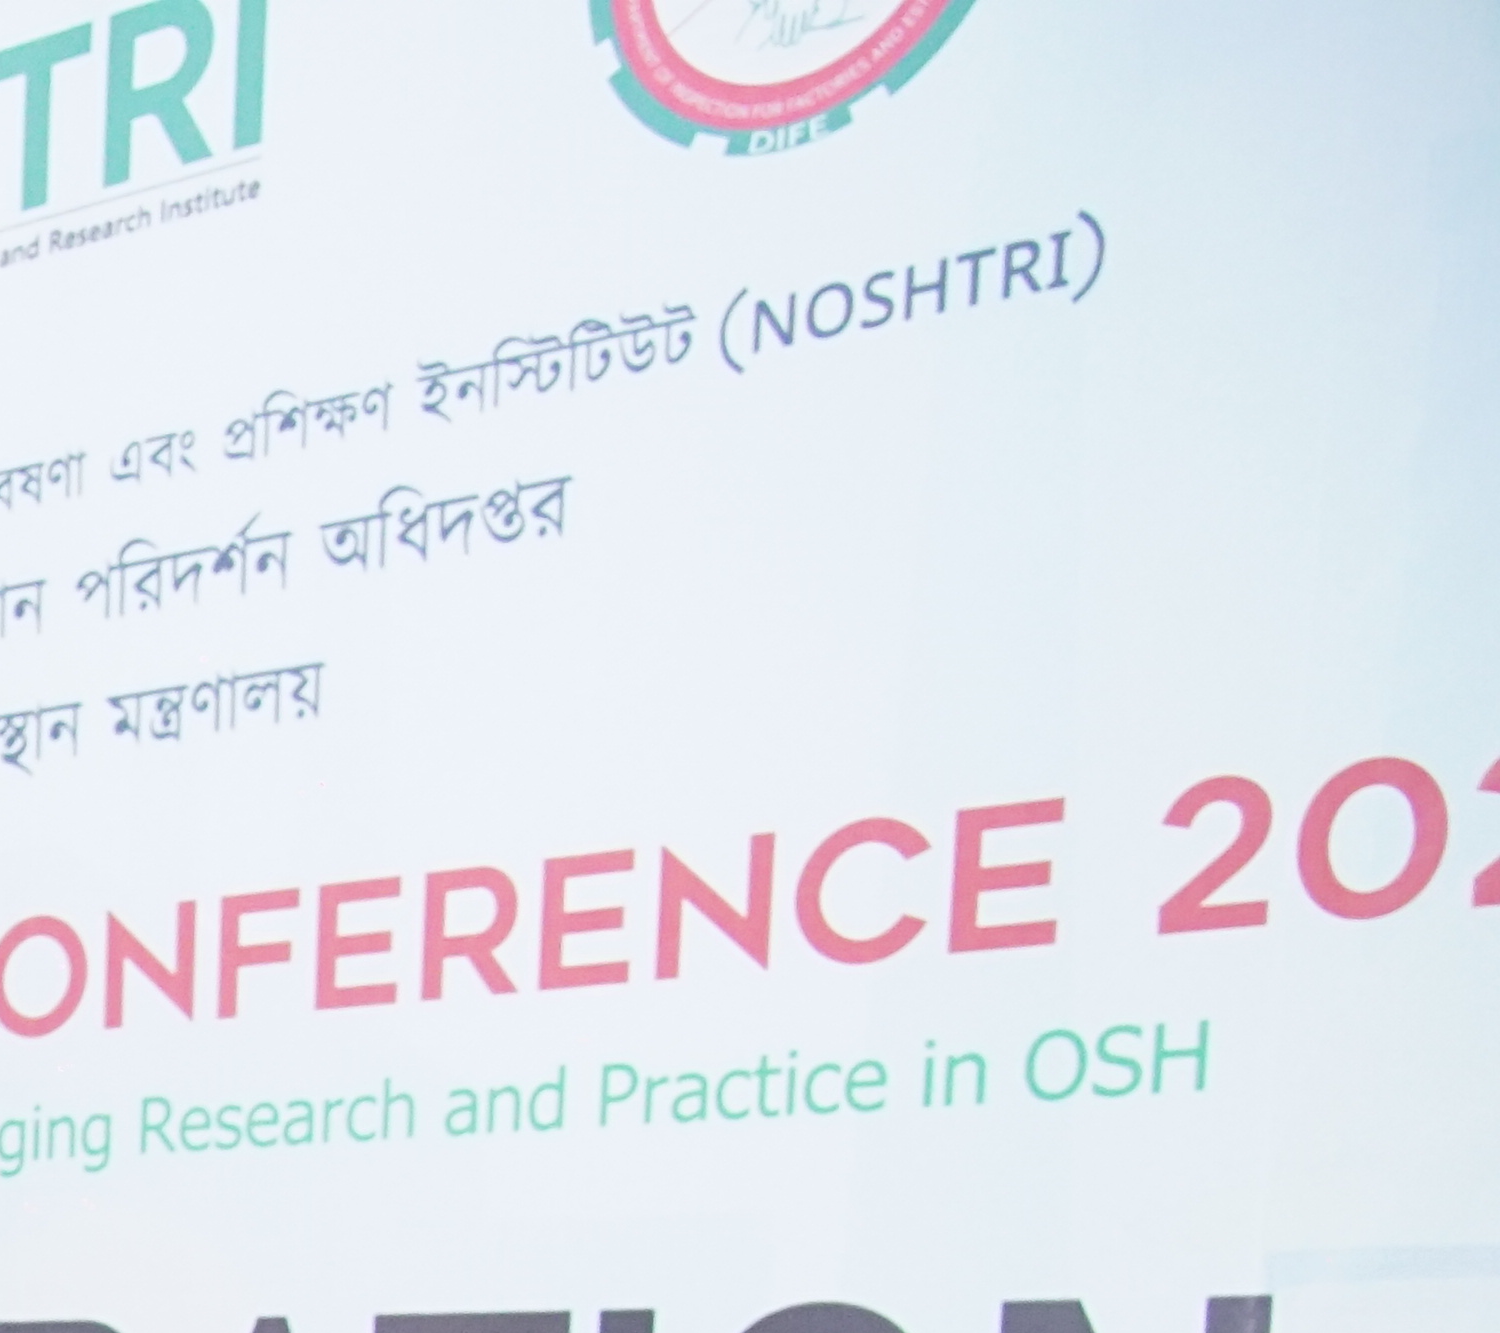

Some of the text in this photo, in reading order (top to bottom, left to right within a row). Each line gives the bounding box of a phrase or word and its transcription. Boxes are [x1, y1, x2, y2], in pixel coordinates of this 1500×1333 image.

[747, 115, 831, 156] DIFE
[0, 236, 41, 270] and
[49, 210, 150, 260] Research
[158, 177, 262, 232] Institute
[111, 432, 197, 481] এবং
[222, 377, 393, 462] প্রশিক্ষণ
[419, 304, 696, 427] ইনস্টিটিউট
[718, 210, 1106, 374] (NOSHTRI)
[77, 511, 290, 624] পরিদর্শন
[321, 470, 572, 569] অধিদপ্তর
[140, 1076, 417, 1152] Research
[444, 1065, 567, 1136] and
[597, 1047, 889, 1128] Practice
[921, 1040, 988, 1110] in
[1023, 1020, 1212, 1104] OSH
